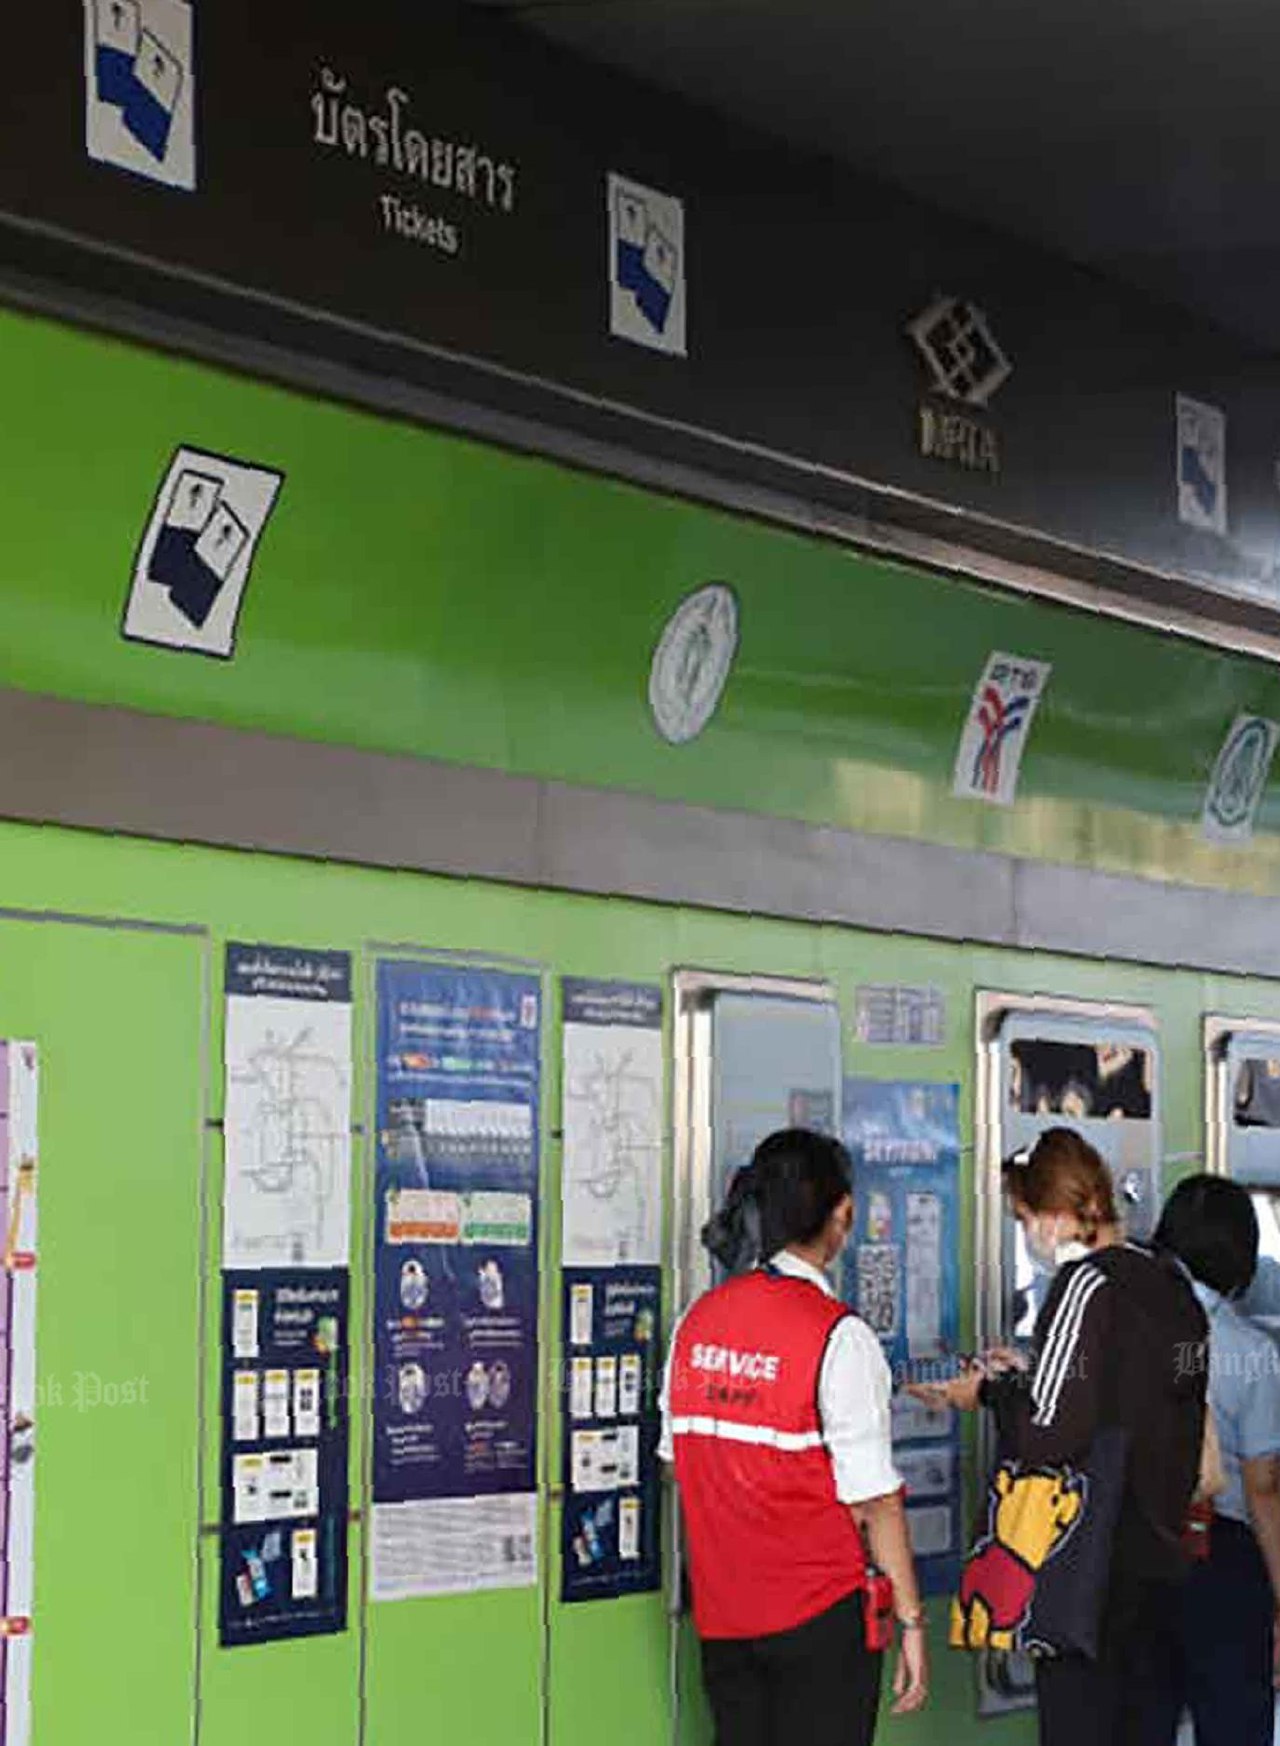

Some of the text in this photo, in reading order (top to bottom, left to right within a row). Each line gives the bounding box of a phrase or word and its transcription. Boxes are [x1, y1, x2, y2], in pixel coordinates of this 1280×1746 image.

[311, 66, 515, 212] บัตรโดยสาร
[380, 195, 458, 253] Tickets
[690, 1342, 779, 1382] SERVICE
